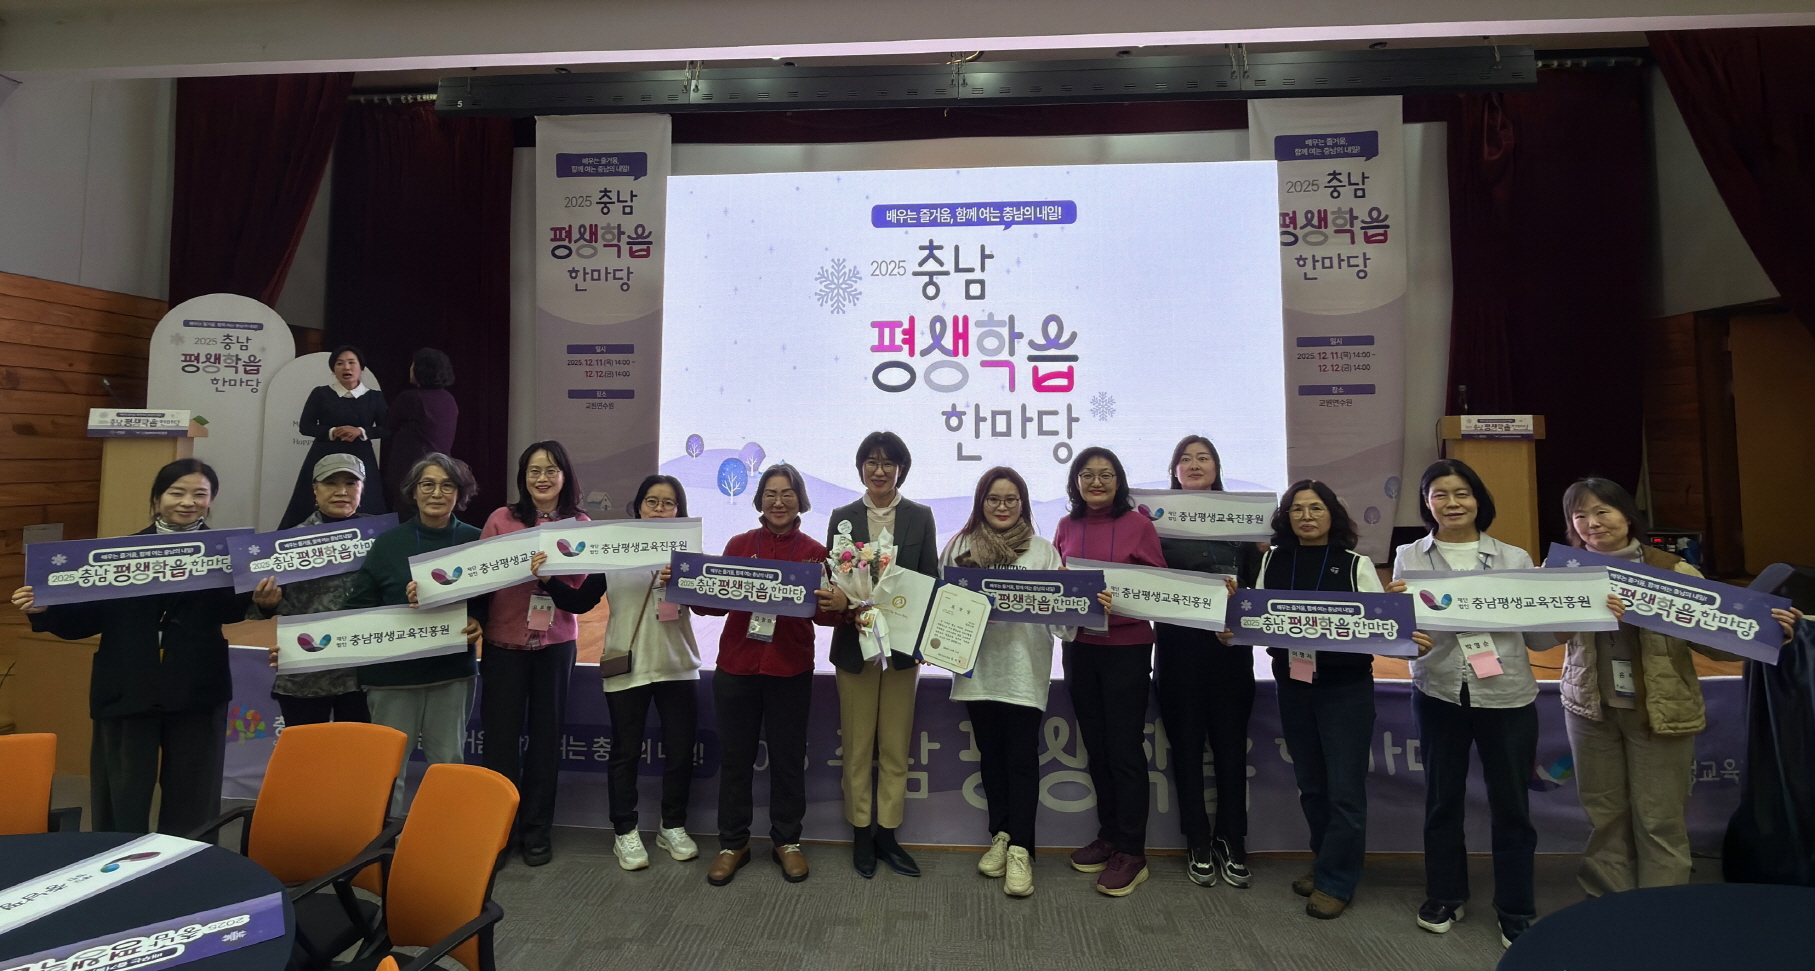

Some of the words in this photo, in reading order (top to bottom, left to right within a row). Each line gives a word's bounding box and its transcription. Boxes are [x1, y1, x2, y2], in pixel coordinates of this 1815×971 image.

[1286, 179, 1320, 194] 2025
[1324, 169, 1370, 199] 충남
[564, 195, 593, 208] 2025
[596, 187, 638, 216] 충남
[886, 208, 918, 223] 배우는
[919, 207, 954, 224] 즐거움,
[955, 206, 977, 222] 함께
[978, 206, 1000, 221] 여는
[1002, 205, 1035, 221] 충남의
[1036, 204, 1062, 220] 내일!
[1279, 206, 1390, 247] 평생학습
[549, 222, 653, 260] 평생학습
[870, 259, 907, 277] 2025
[912, 238, 995, 301] 충남
[1294, 252, 1371, 281] 한마당
[567, 266, 634, 292] 한마당
[194, 337, 218, 345] 2025
[220, 333, 252, 351] 충남
[870, 312, 1079, 393] 평생학습
[181, 352, 262, 375] 평생학습
[210, 377, 261, 393] 한마당
[941, 403, 1080, 465] 한마당
[1179, 511, 1264, 524] 충남평생교육진흥원
[273, 555, 295, 569] 충남
[297, 544, 351, 567] 평생학습
[352, 540, 374, 554] 한마
[601, 540, 688, 555] 충남평생교육진흥원
[52, 573, 75, 583] 2025
[78, 567, 110, 585] 충남
[113, 558, 188, 583] 평생학습
[680, 579, 695, 587] 2025
[696, 580, 716, 593] 충남
[718, 580, 768, 599] 평생학습
[771, 586, 804, 600] 한마당
[1121, 587, 1211, 609] 충남평생교육진흥원
[998, 593, 1050, 613] 평생학습
[1053, 598, 1088, 612] 한마당
[1472, 596, 1591, 609] 충남평생교육진흥원
[1617, 586, 1696, 624] 평생학습
[1700, 610, 1755, 638] 한마당
[350, 624, 450, 646] 충남평생교육진흥원
[1242, 619, 1260, 627] 2025
[1262, 617, 1286, 632] 충남
[1288, 616, 1350, 638] 평생학습
[1354, 619, 1396, 637] 한마당
